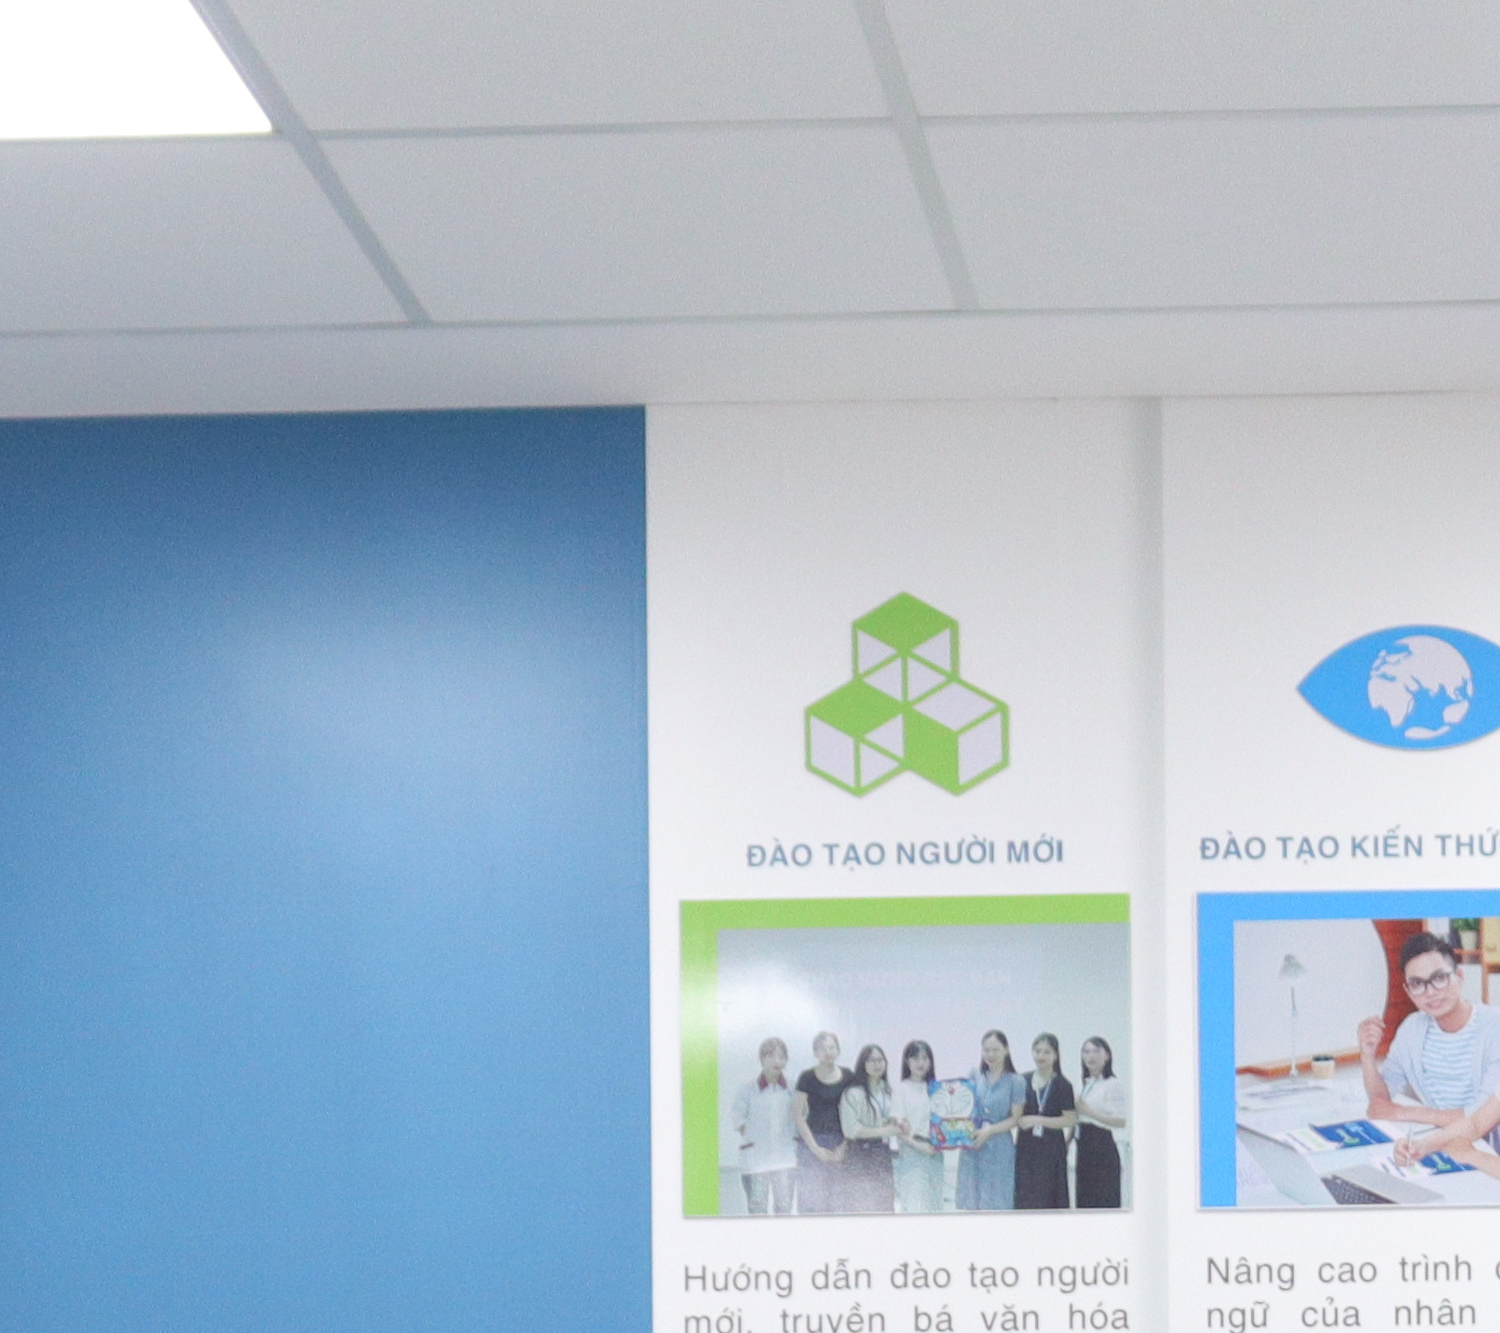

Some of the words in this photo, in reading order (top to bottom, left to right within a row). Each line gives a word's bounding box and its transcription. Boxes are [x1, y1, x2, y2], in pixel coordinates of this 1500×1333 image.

[745, 837, 813, 868] ĐÀO
[821, 841, 887, 872] TẠO
[895, 834, 996, 866] NGƯỜI
[1006, 833, 1064, 864] MỚI
[1199, 830, 1267, 861] ĐÀO
[1275, 835, 1340, 866] TẠO
[1350, 825, 1423, 859] KIẾN
[684, 1263, 794, 1299] Hướng
[810, 1258, 872, 1291] dẫn
[889, 1260, 952, 1290] đào
[968, 1262, 1020, 1294] tạo
[1037, 1257, 1129, 1295] người
[1206, 1256, 1296, 1292] Nâng
[1317, 1261, 1378, 1284] cao
[1398, 1253, 1472, 1283] trình
